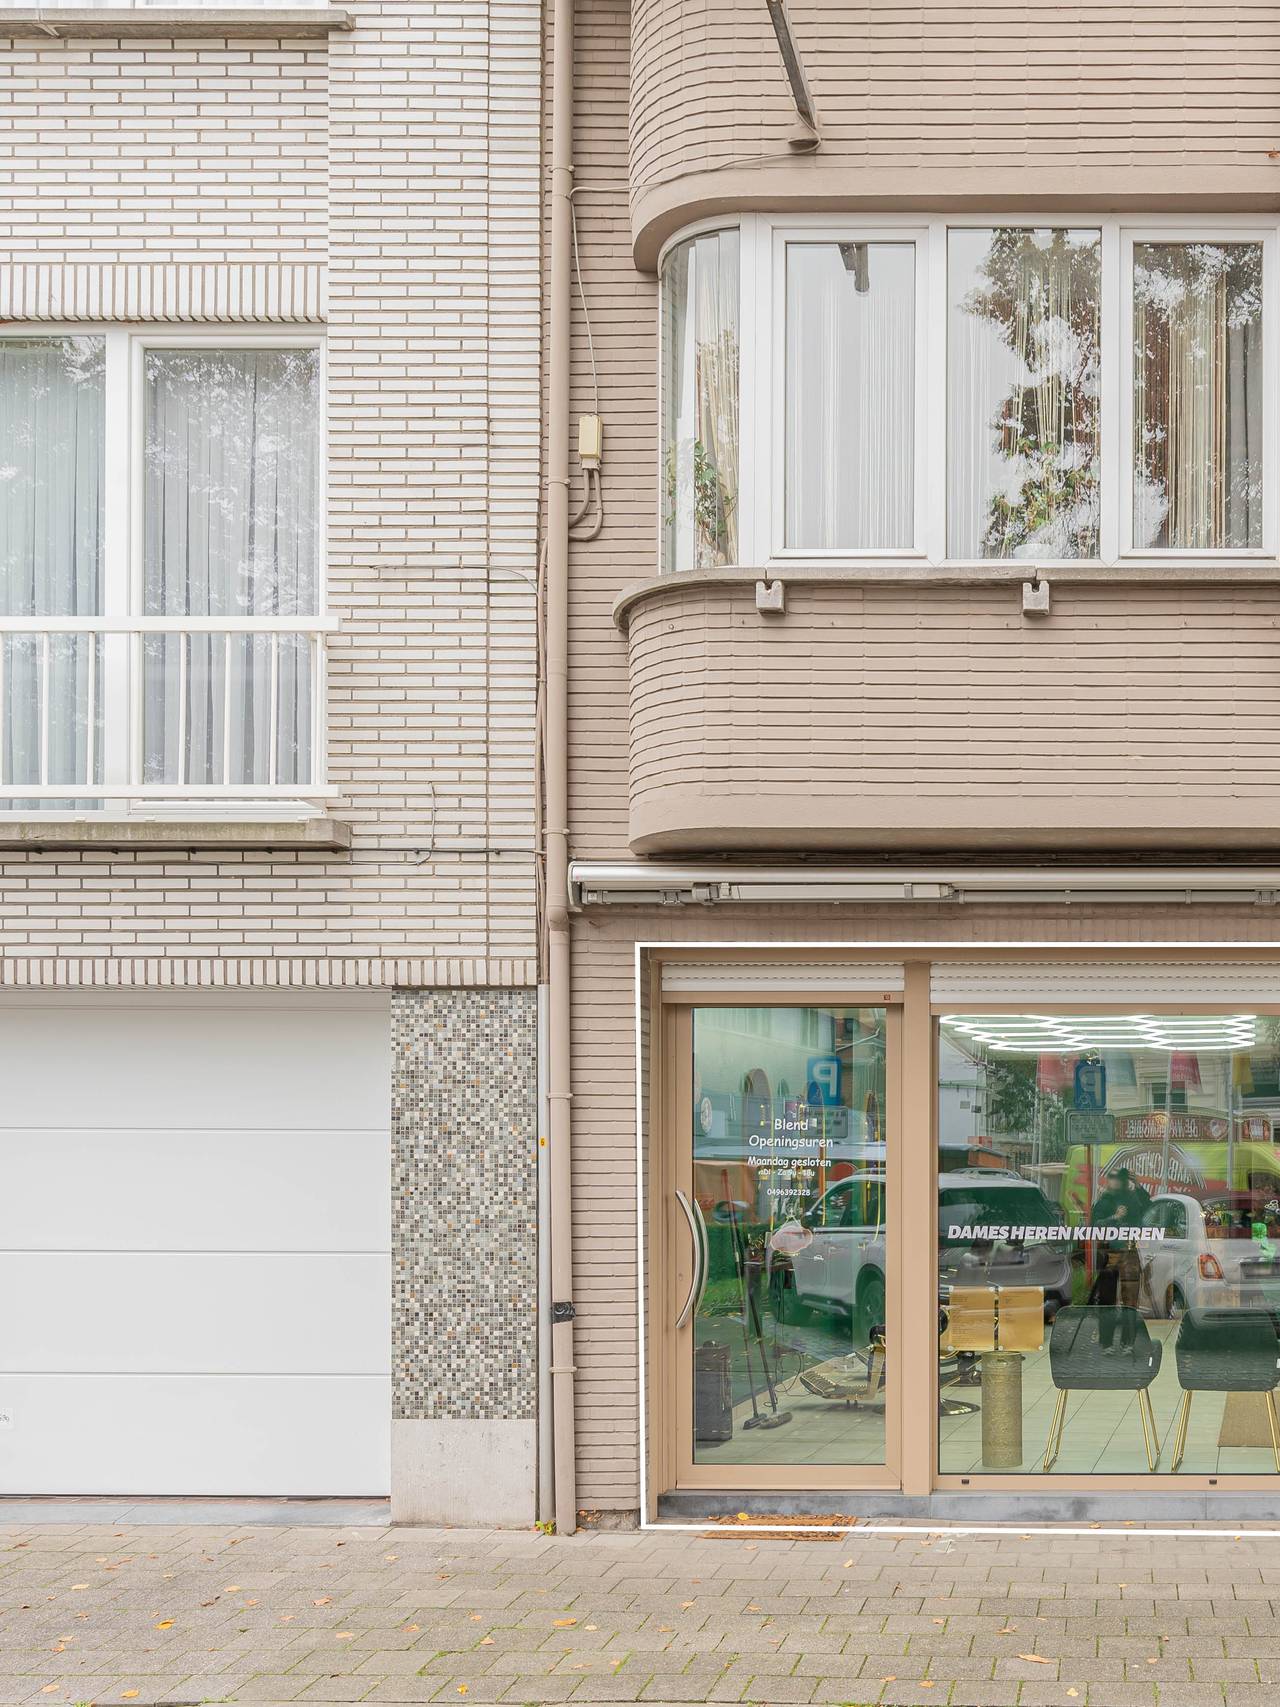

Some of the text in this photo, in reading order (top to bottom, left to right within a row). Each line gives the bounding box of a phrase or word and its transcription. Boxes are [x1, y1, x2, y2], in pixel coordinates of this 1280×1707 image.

[774, 1118, 809, 1131] Blend
[748, 1134, 834, 1150] Openingsuren
[747, 1156, 832, 1169] Maandag gesloten
[947, 1225, 1166, 1241] DAMES HEREN KINDEREN
